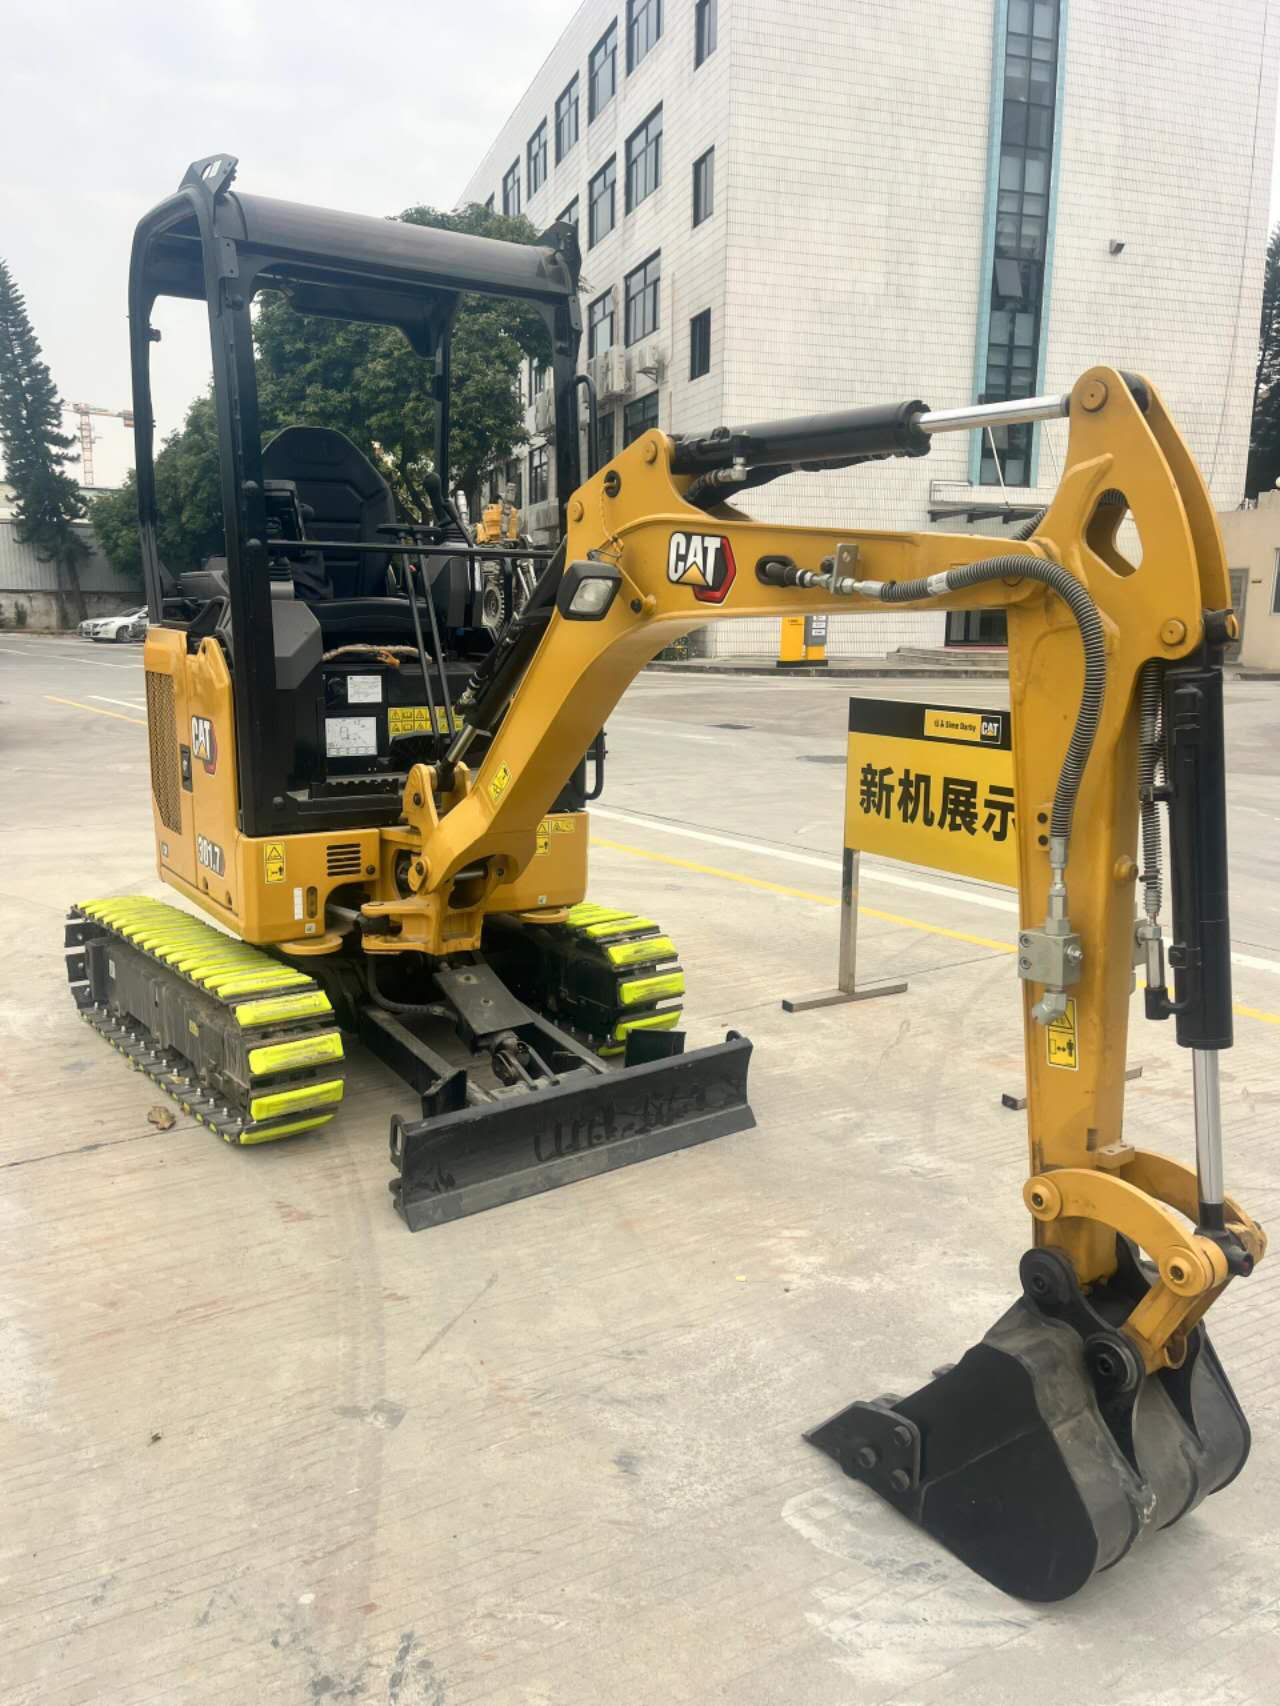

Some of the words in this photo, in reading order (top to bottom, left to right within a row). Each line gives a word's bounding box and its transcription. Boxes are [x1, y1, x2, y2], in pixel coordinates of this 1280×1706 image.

[667, 531, 721, 587] CAT
[191, 716, 211, 760] CAT
[982, 720, 999, 736] CAT
[859, 763, 1016, 842] 新机展示
